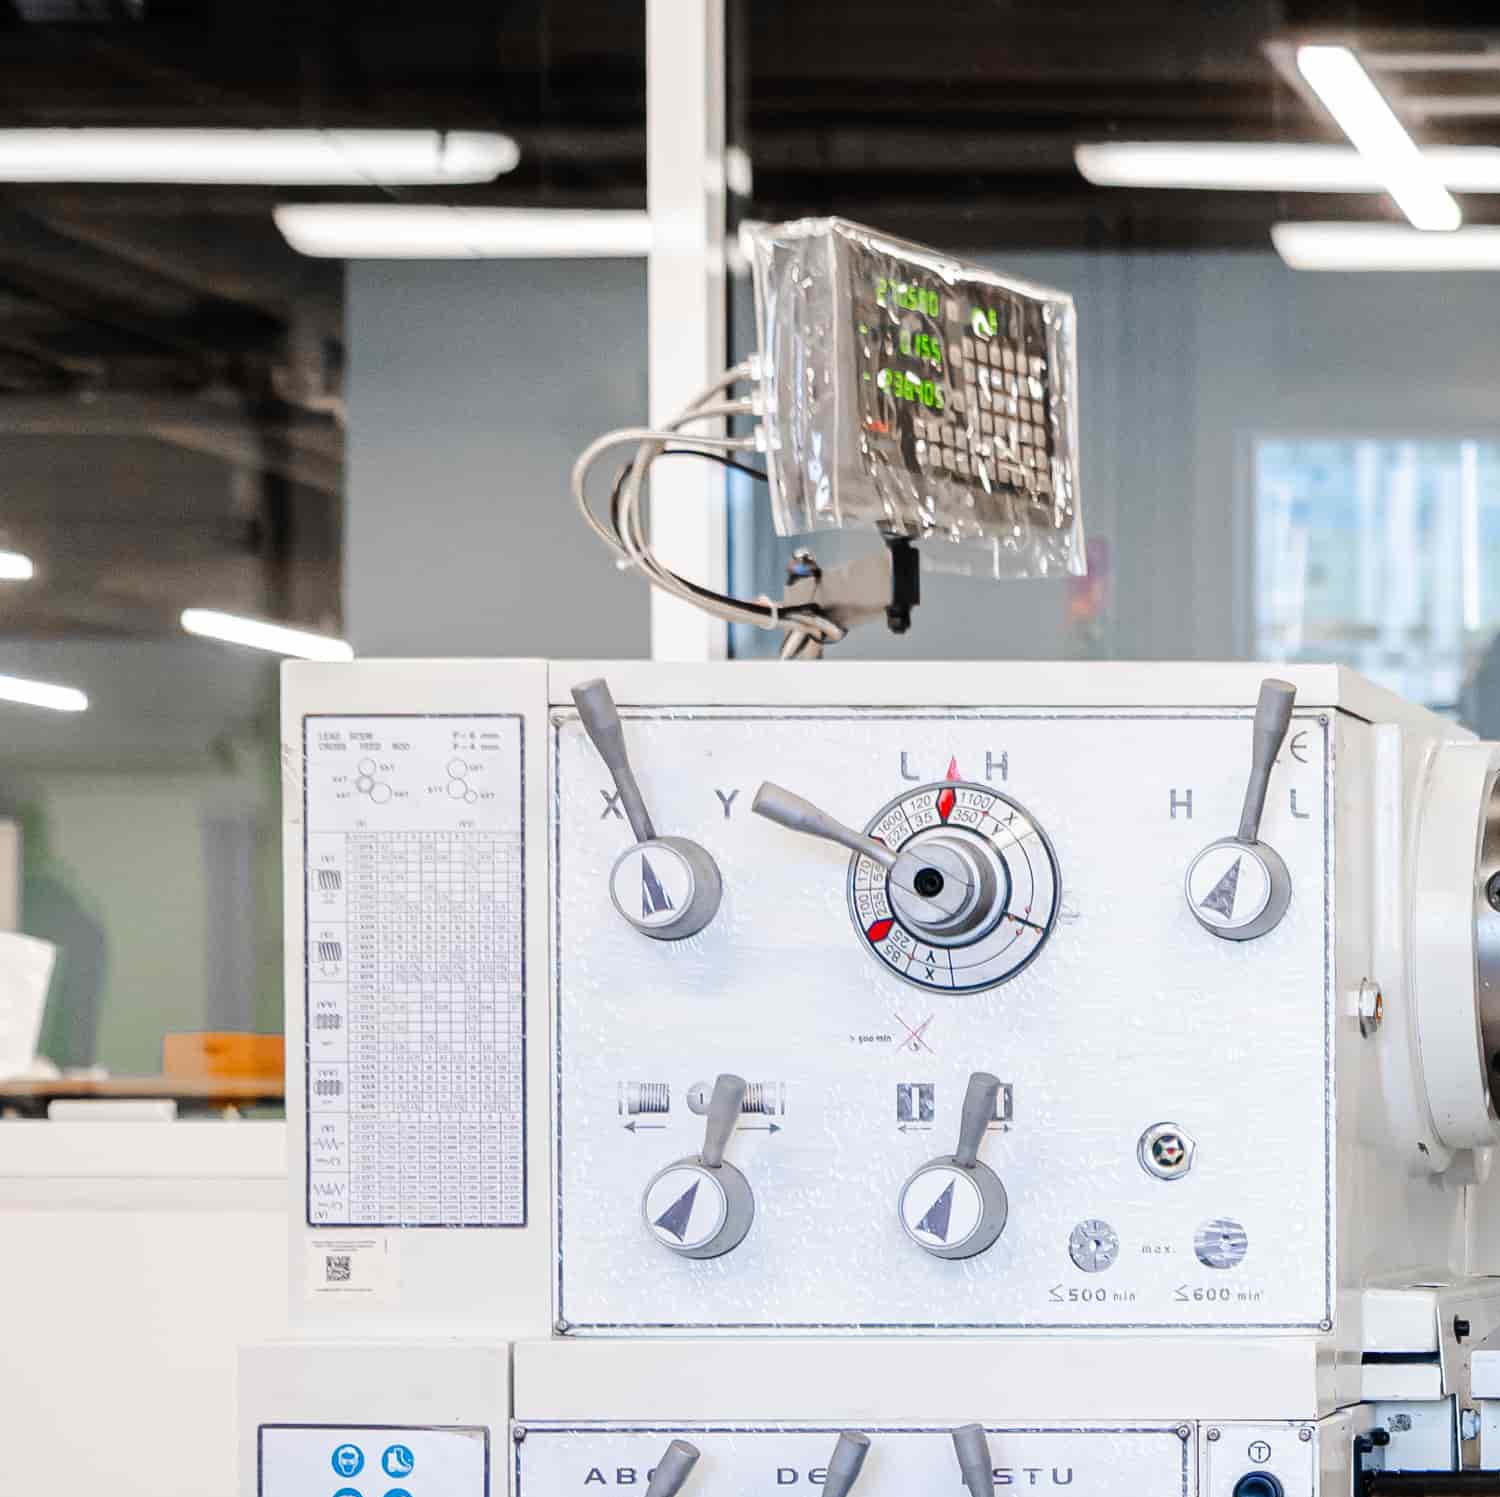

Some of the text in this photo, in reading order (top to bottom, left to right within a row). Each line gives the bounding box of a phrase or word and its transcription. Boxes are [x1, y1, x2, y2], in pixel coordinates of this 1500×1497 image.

[900, 752, 920, 781] L
[986, 752, 1008, 781] H
[714, 789, 740, 819] Y
[910, 794, 931, 810] 120
[959, 792, 990, 809] 1100
[1170, 789, 1192, 819] H
[952, 808, 977, 823] 350
[860, 894, 871, 918] 700
